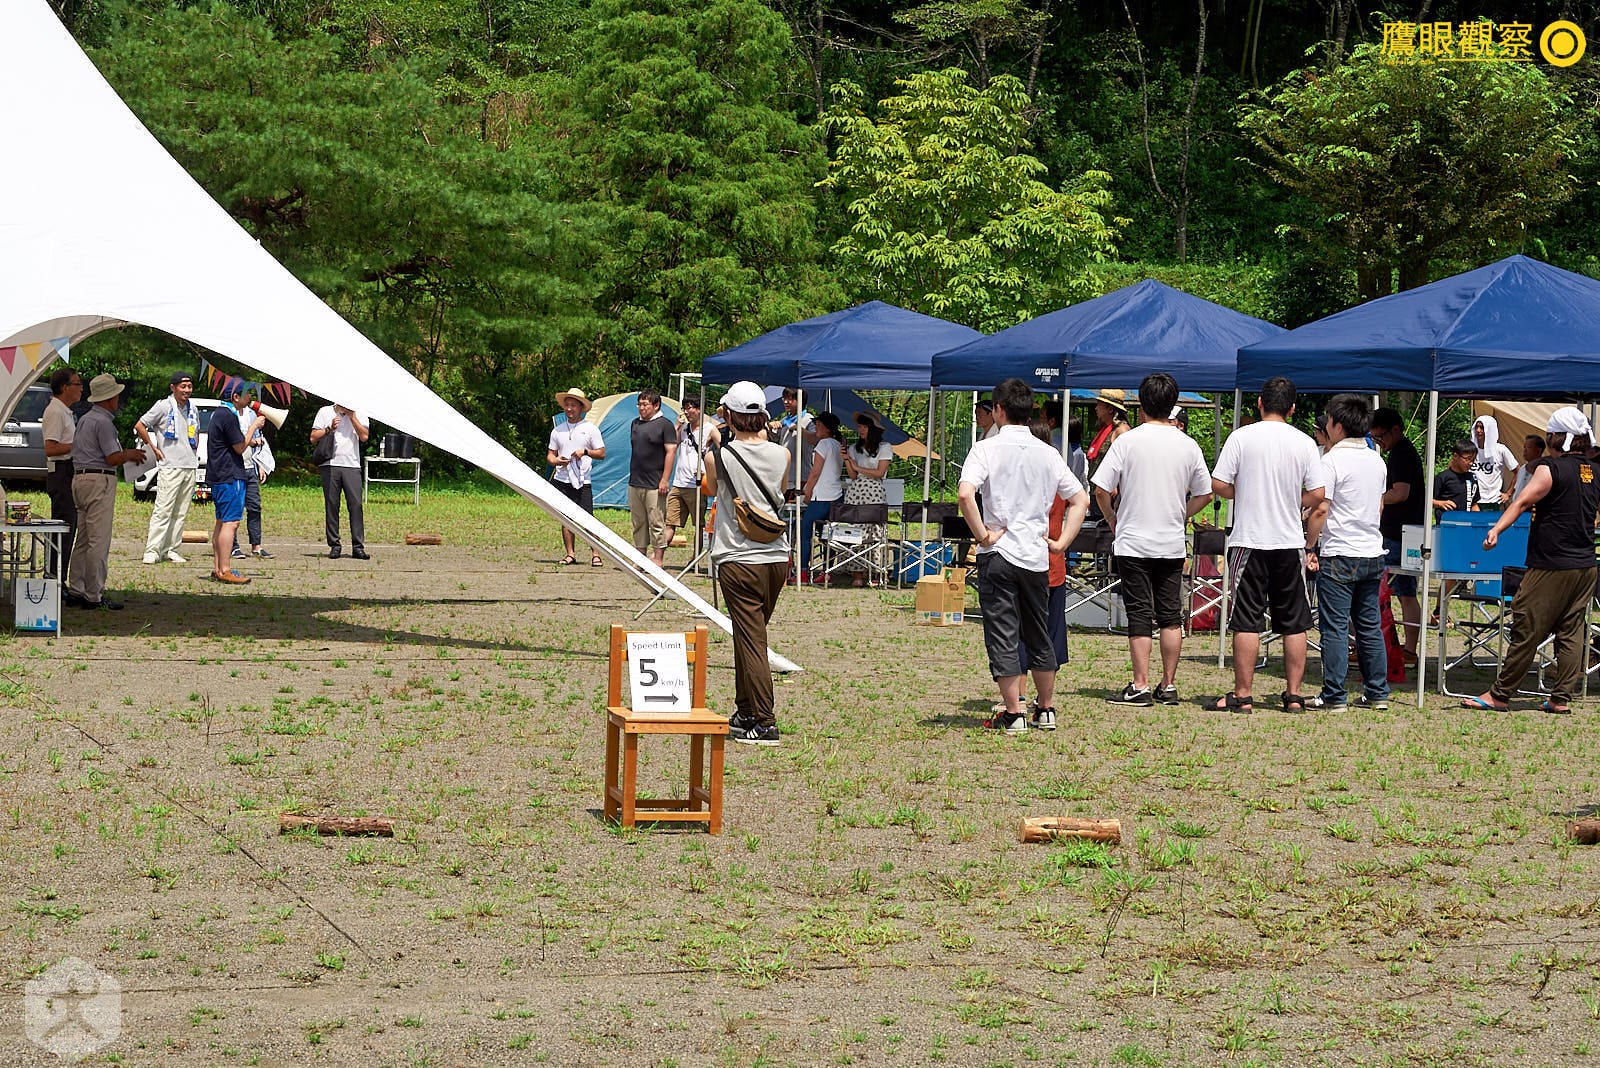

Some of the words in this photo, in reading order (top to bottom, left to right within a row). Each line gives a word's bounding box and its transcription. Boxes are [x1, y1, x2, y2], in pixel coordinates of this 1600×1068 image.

[632, 641, 658, 650] Speed
[660, 641, 681, 649] Limit
[639, 658, 659, 687] 5
